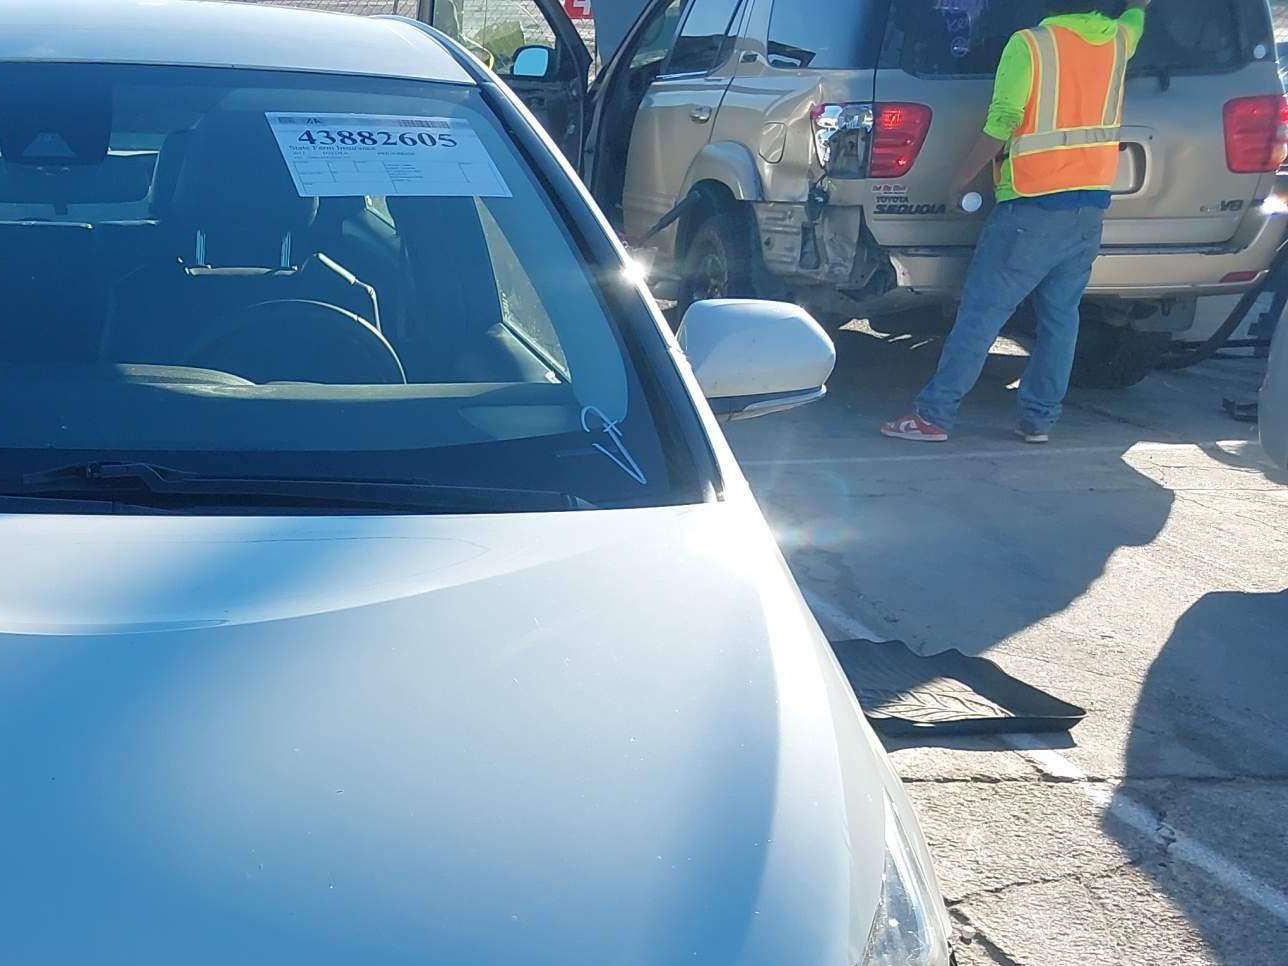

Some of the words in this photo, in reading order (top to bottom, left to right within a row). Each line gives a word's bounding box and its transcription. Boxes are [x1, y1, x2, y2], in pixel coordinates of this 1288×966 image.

[297, 129, 457, 148] 43882605
[875, 195, 910, 204] TOYOTA
[873, 204, 946, 215] SEQUOIA
